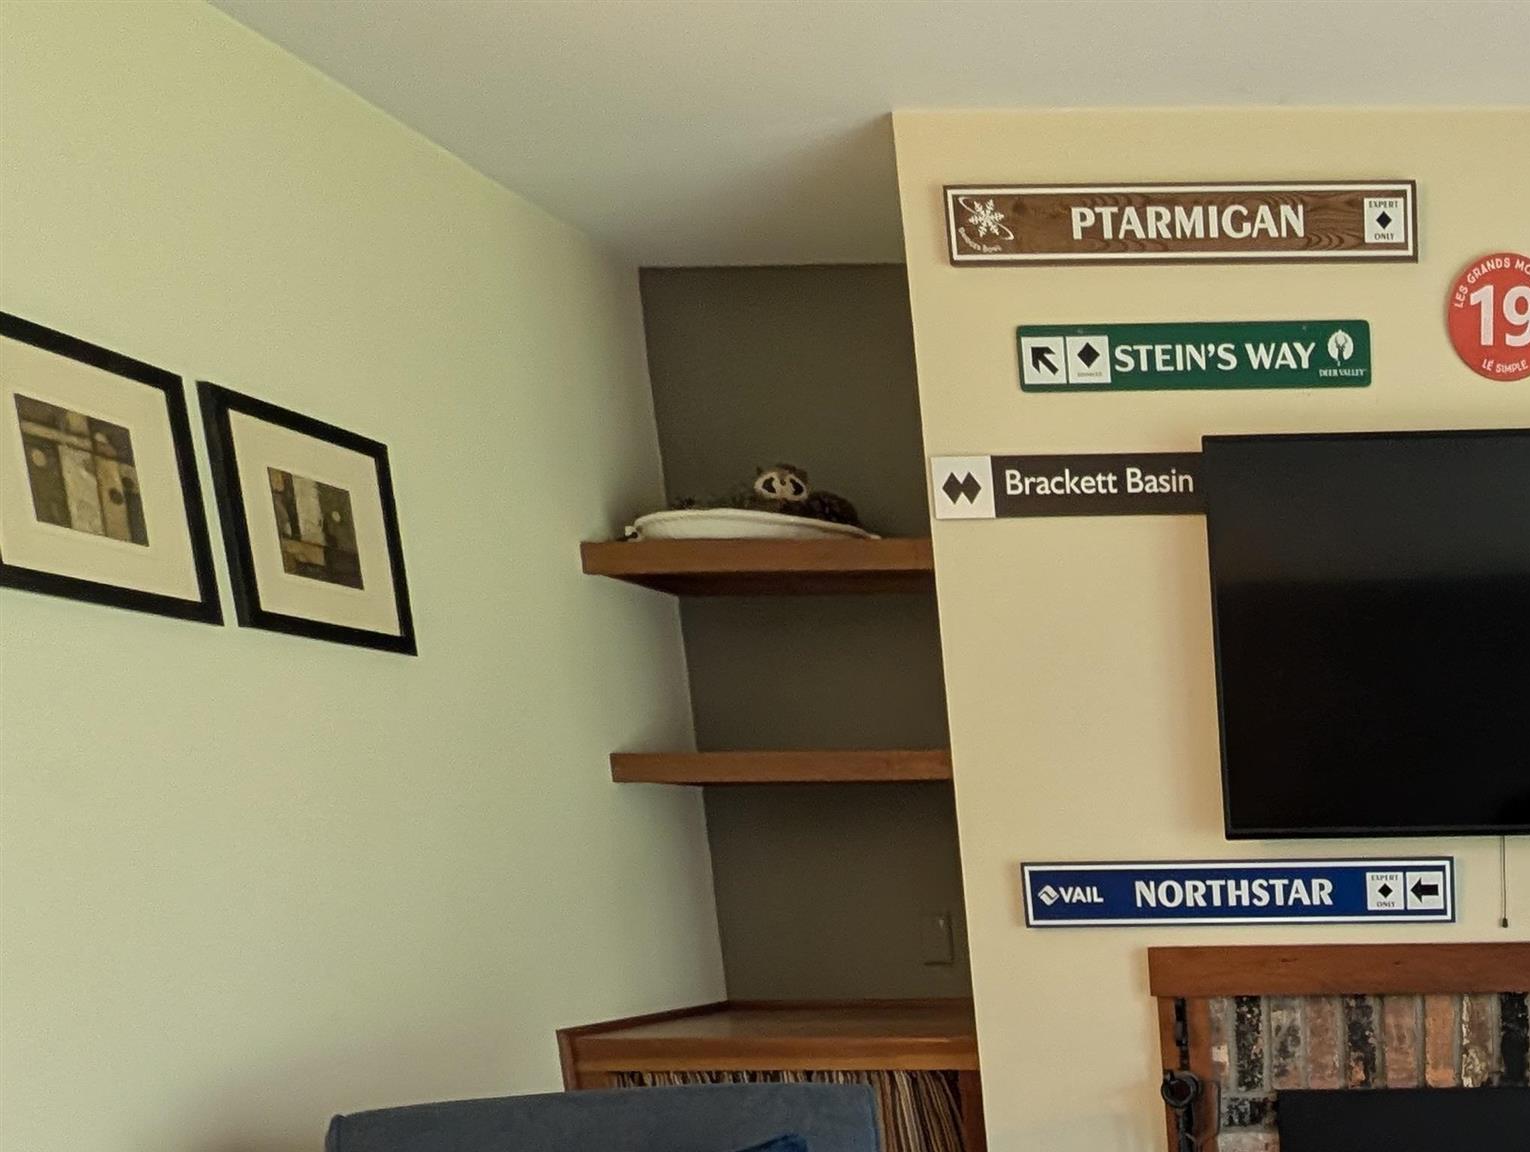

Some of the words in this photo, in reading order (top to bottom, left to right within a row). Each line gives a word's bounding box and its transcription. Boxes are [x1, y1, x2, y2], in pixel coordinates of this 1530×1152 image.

[1369, 200, 1398, 208] EXPERT
[1070, 203, 1305, 240] PTARMIGAN
[1374, 232, 1394, 241] ONLY
[1454, 285, 1469, 309] LES
[1466, 257, 1511, 284] GRANDS
[1245, 341, 1316, 369] WAY
[1482, 358, 1494, 371] LE
[1495, 359, 1528, 373] SIMPLE
[1005, 468, 1119, 495] Brackett
[1126, 467, 1194, 494] Basin
[1059, 886, 1104, 904] VAIL
[1134, 878, 1334, 908] NORTHSTAR
